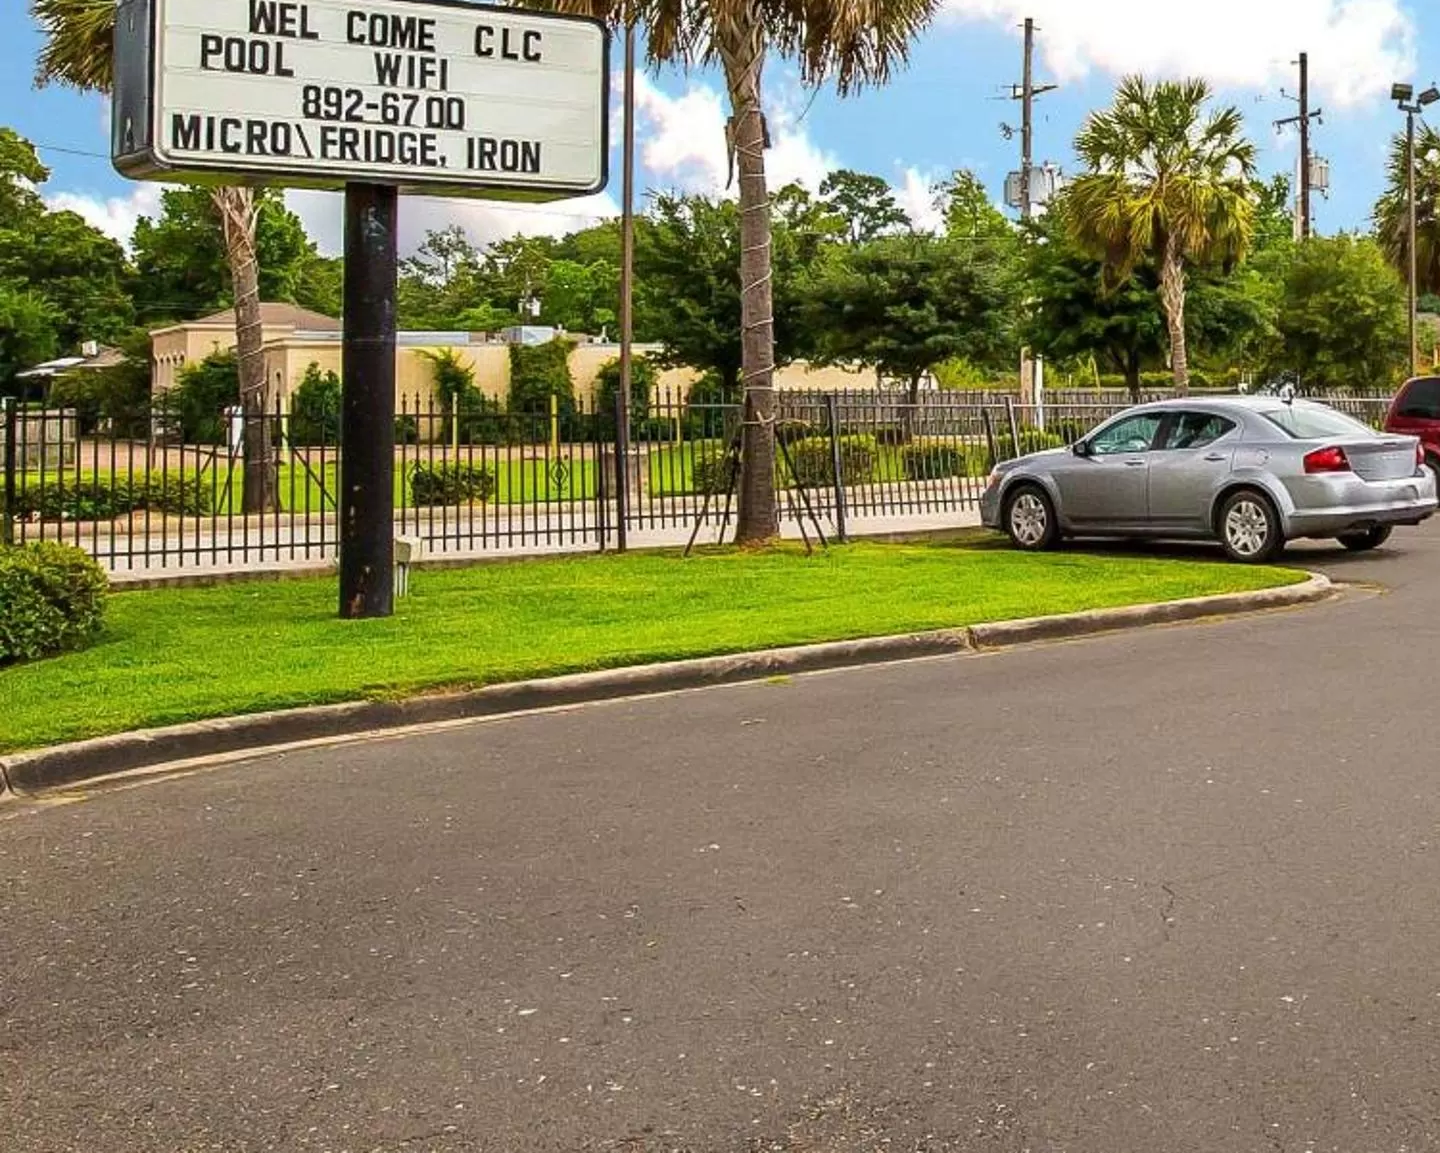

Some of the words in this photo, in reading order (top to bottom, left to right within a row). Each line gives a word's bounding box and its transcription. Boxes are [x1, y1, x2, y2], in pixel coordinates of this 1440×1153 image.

[201, 34, 294, 77] POOL
[374, 51, 448, 91] WIFI
[474, 25, 542, 62] CLC
[302, 84, 465, 131] 892-6700
[467, 137, 541, 173] IRON
